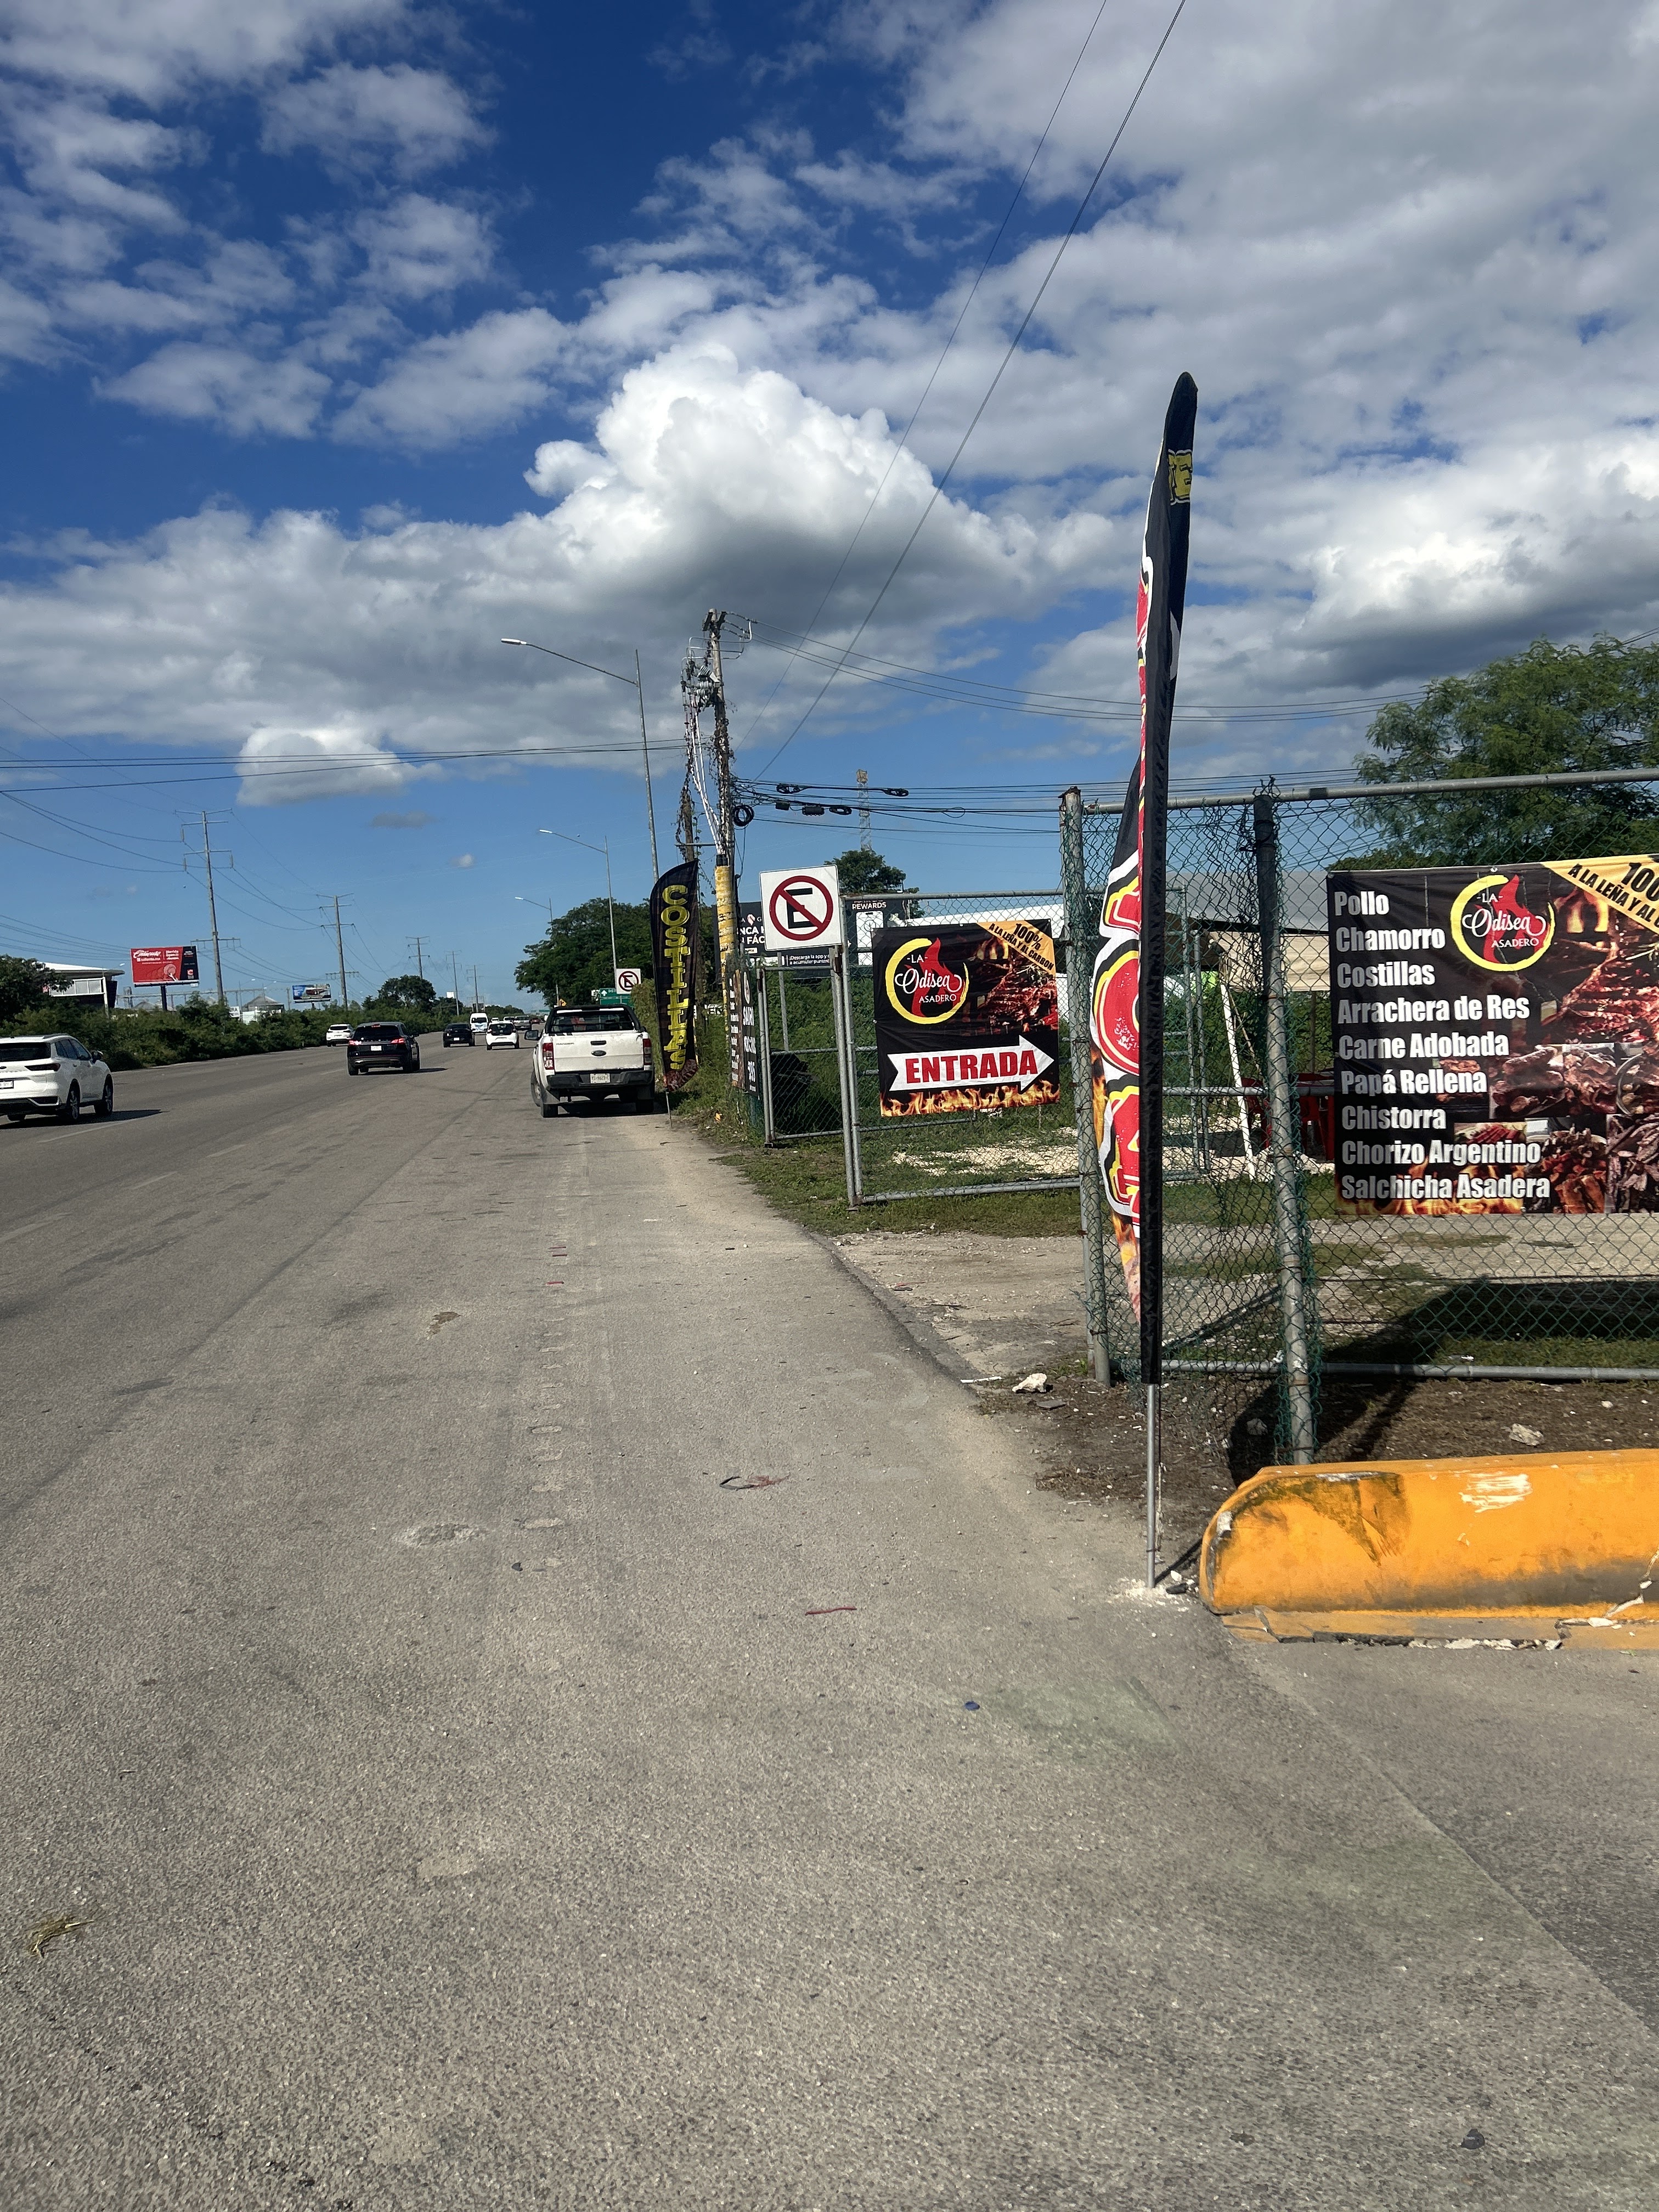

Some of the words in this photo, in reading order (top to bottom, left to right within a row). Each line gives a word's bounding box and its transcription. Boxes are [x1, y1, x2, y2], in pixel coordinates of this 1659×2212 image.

[852, 901, 887, 910] REWARDS
[1334, 890, 1390, 916] Pollo
[1567, 863, 1583, 878] A
[1578, 868, 1599, 888] LA
[1595, 879, 1630, 907] LEÑA
[1628, 897, 1642, 911] Y
[1635, 904, 1657, 922] AL
[1013, 923, 1042, 950] 100%
[1462, 908, 1546, 938] Odisea
[989, 923, 995, 931] A
[994, 926, 1003, 936] LA
[1020, 945, 1029, 954] AL
[1028, 950, 1054, 970] CARBON
[1335, 927, 1446, 952] Chamorro
[1491, 938, 1539, 948] ASADERO
[661, 884, 691, 1070] COSTILLAS
[895, 968, 962, 994] Odisea
[1337, 961, 1435, 988] Costillas
[918, 994, 957, 1003] ASADERO
[1338, 998, 1450, 1024] Arrachera
[1454, 996, 1482, 1020] de
[1486, 995, 1530, 1019] Res
[1338, 1035, 1406, 1060] Carne
[1409, 1031, 1509, 1058] Adobada
[905, 1049, 1038, 1084] ENTRADA
[1341, 1069, 1397, 1097] Papá
[1400, 1069, 1487, 1094] Rellena
[1341, 1105, 1447, 1130] Chistorra
[1341, 1141, 1425, 1165] Chorizo
[1429, 1139, 1541, 1166] Argentino
[1341, 1175, 1452, 1200] Salchicha
[1456, 1174, 1550, 1200] Asadera
